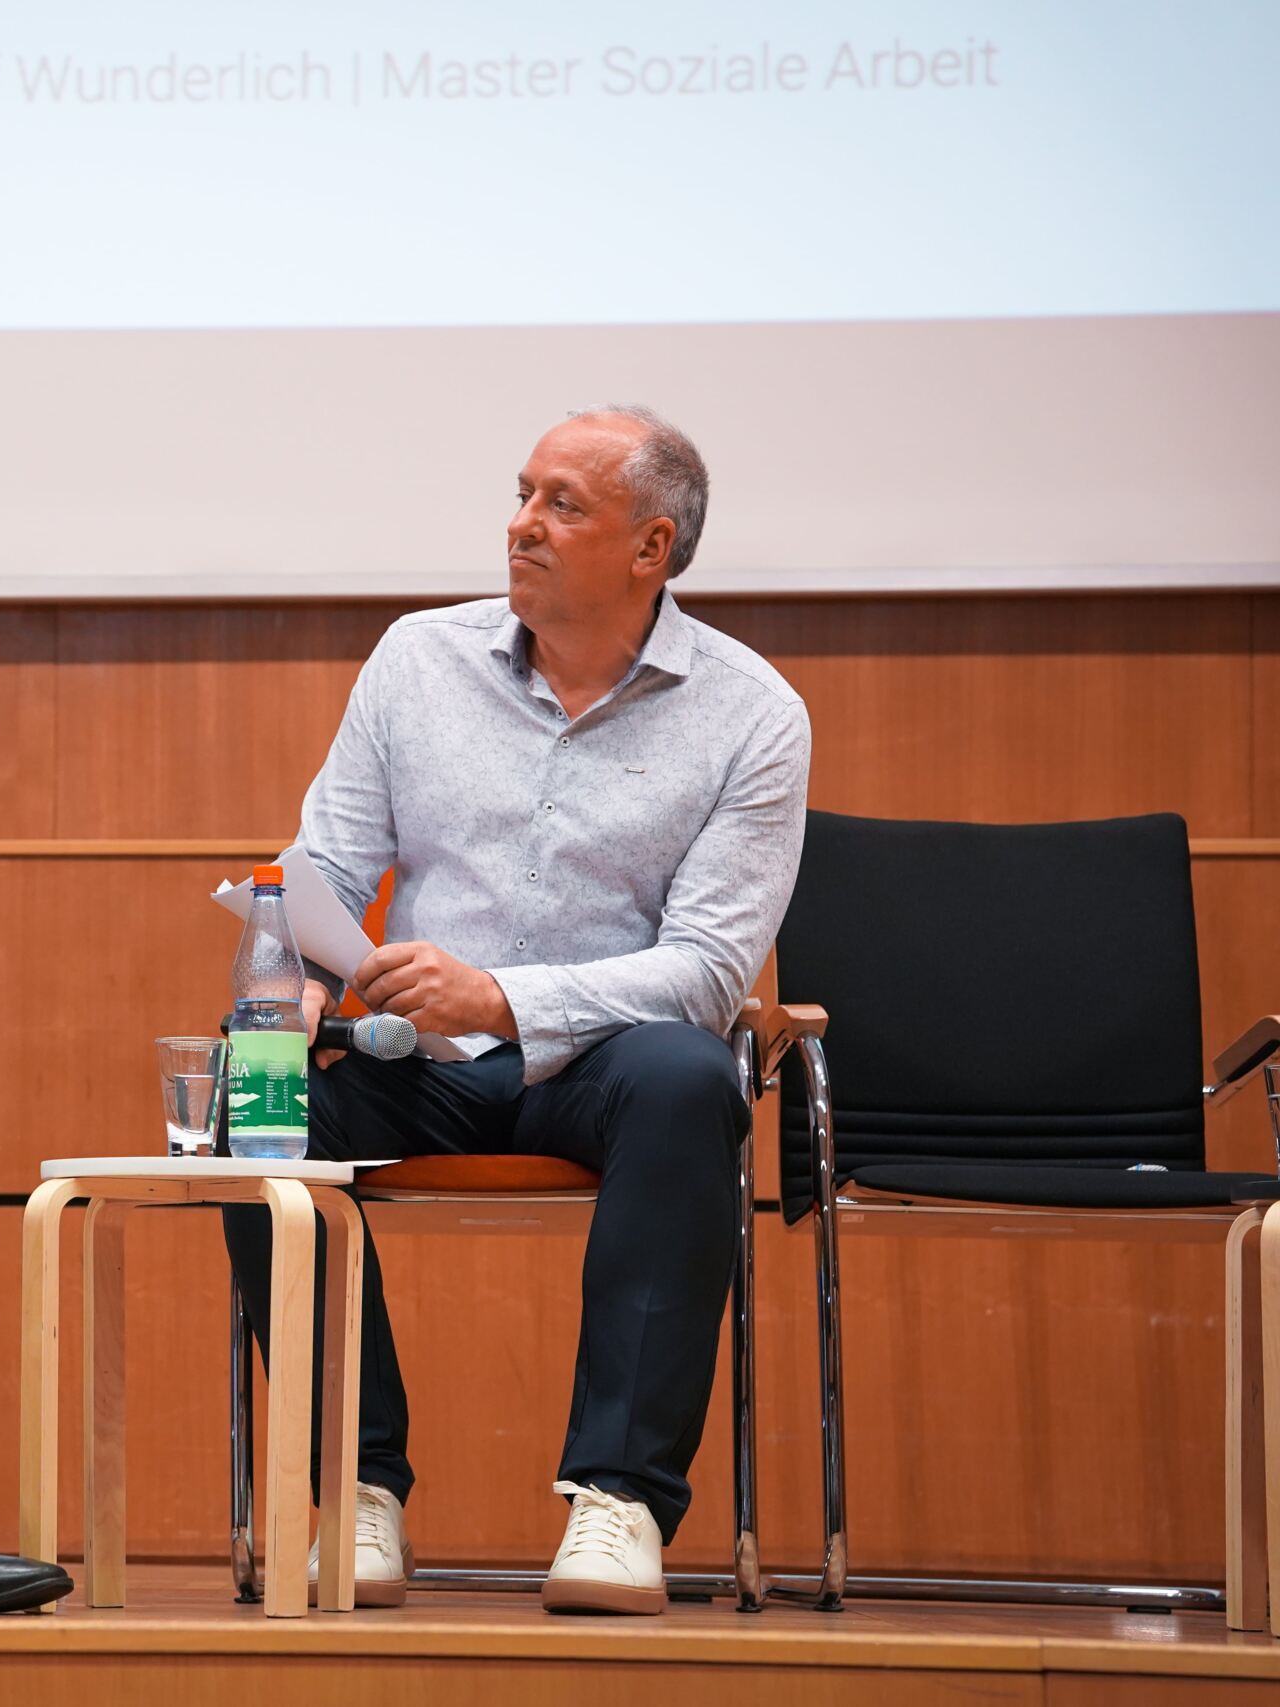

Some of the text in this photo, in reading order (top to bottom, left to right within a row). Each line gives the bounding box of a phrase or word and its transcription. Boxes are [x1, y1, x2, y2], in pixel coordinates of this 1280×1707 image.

[16, 51, 333, 105] Wunderlich
[381, 51, 582, 100] Master
[600, 41, 809, 97] Soziale
[823, 37, 1000, 90] Arbeit
[229, 1062, 250, 1079] SIA
